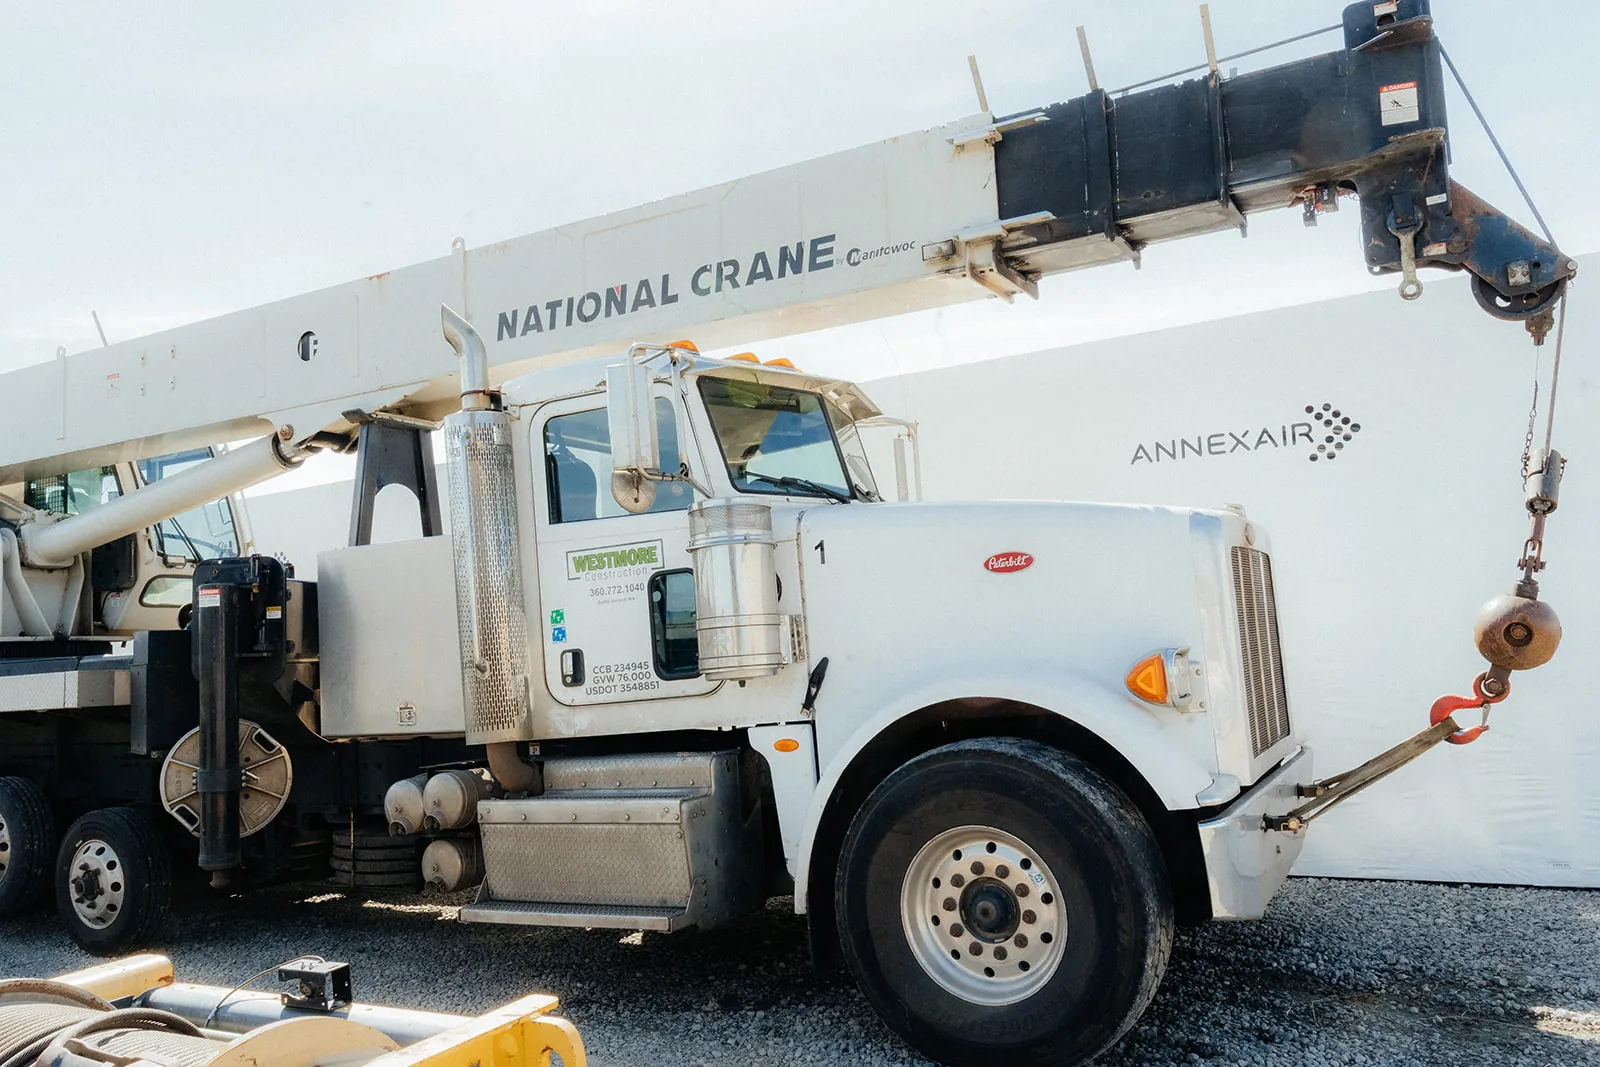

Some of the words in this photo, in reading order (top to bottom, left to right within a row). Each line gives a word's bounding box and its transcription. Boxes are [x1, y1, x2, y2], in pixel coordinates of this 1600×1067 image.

[497, 273, 679, 341] NATIONAL
[691, 233, 836, 297] CRANE
[847, 240, 916, 267] Manitowoc
[1130, 422, 1314, 465] ANNEXAIR
[572, 545, 658, 573] WESTMORE
[814, 539, 825, 564] 1
[988, 555, 1029, 570] Peterbilt
[584, 567, 648, 582] Construction
[589, 582, 645, 597] 360.772.1040
[592, 665, 612, 675] CCB
[614, 661, 649, 673] 234945
[593, 674, 615, 685] GVW
[585, 684, 617, 696] USDOT
[620, 681, 660, 693] 3548851
